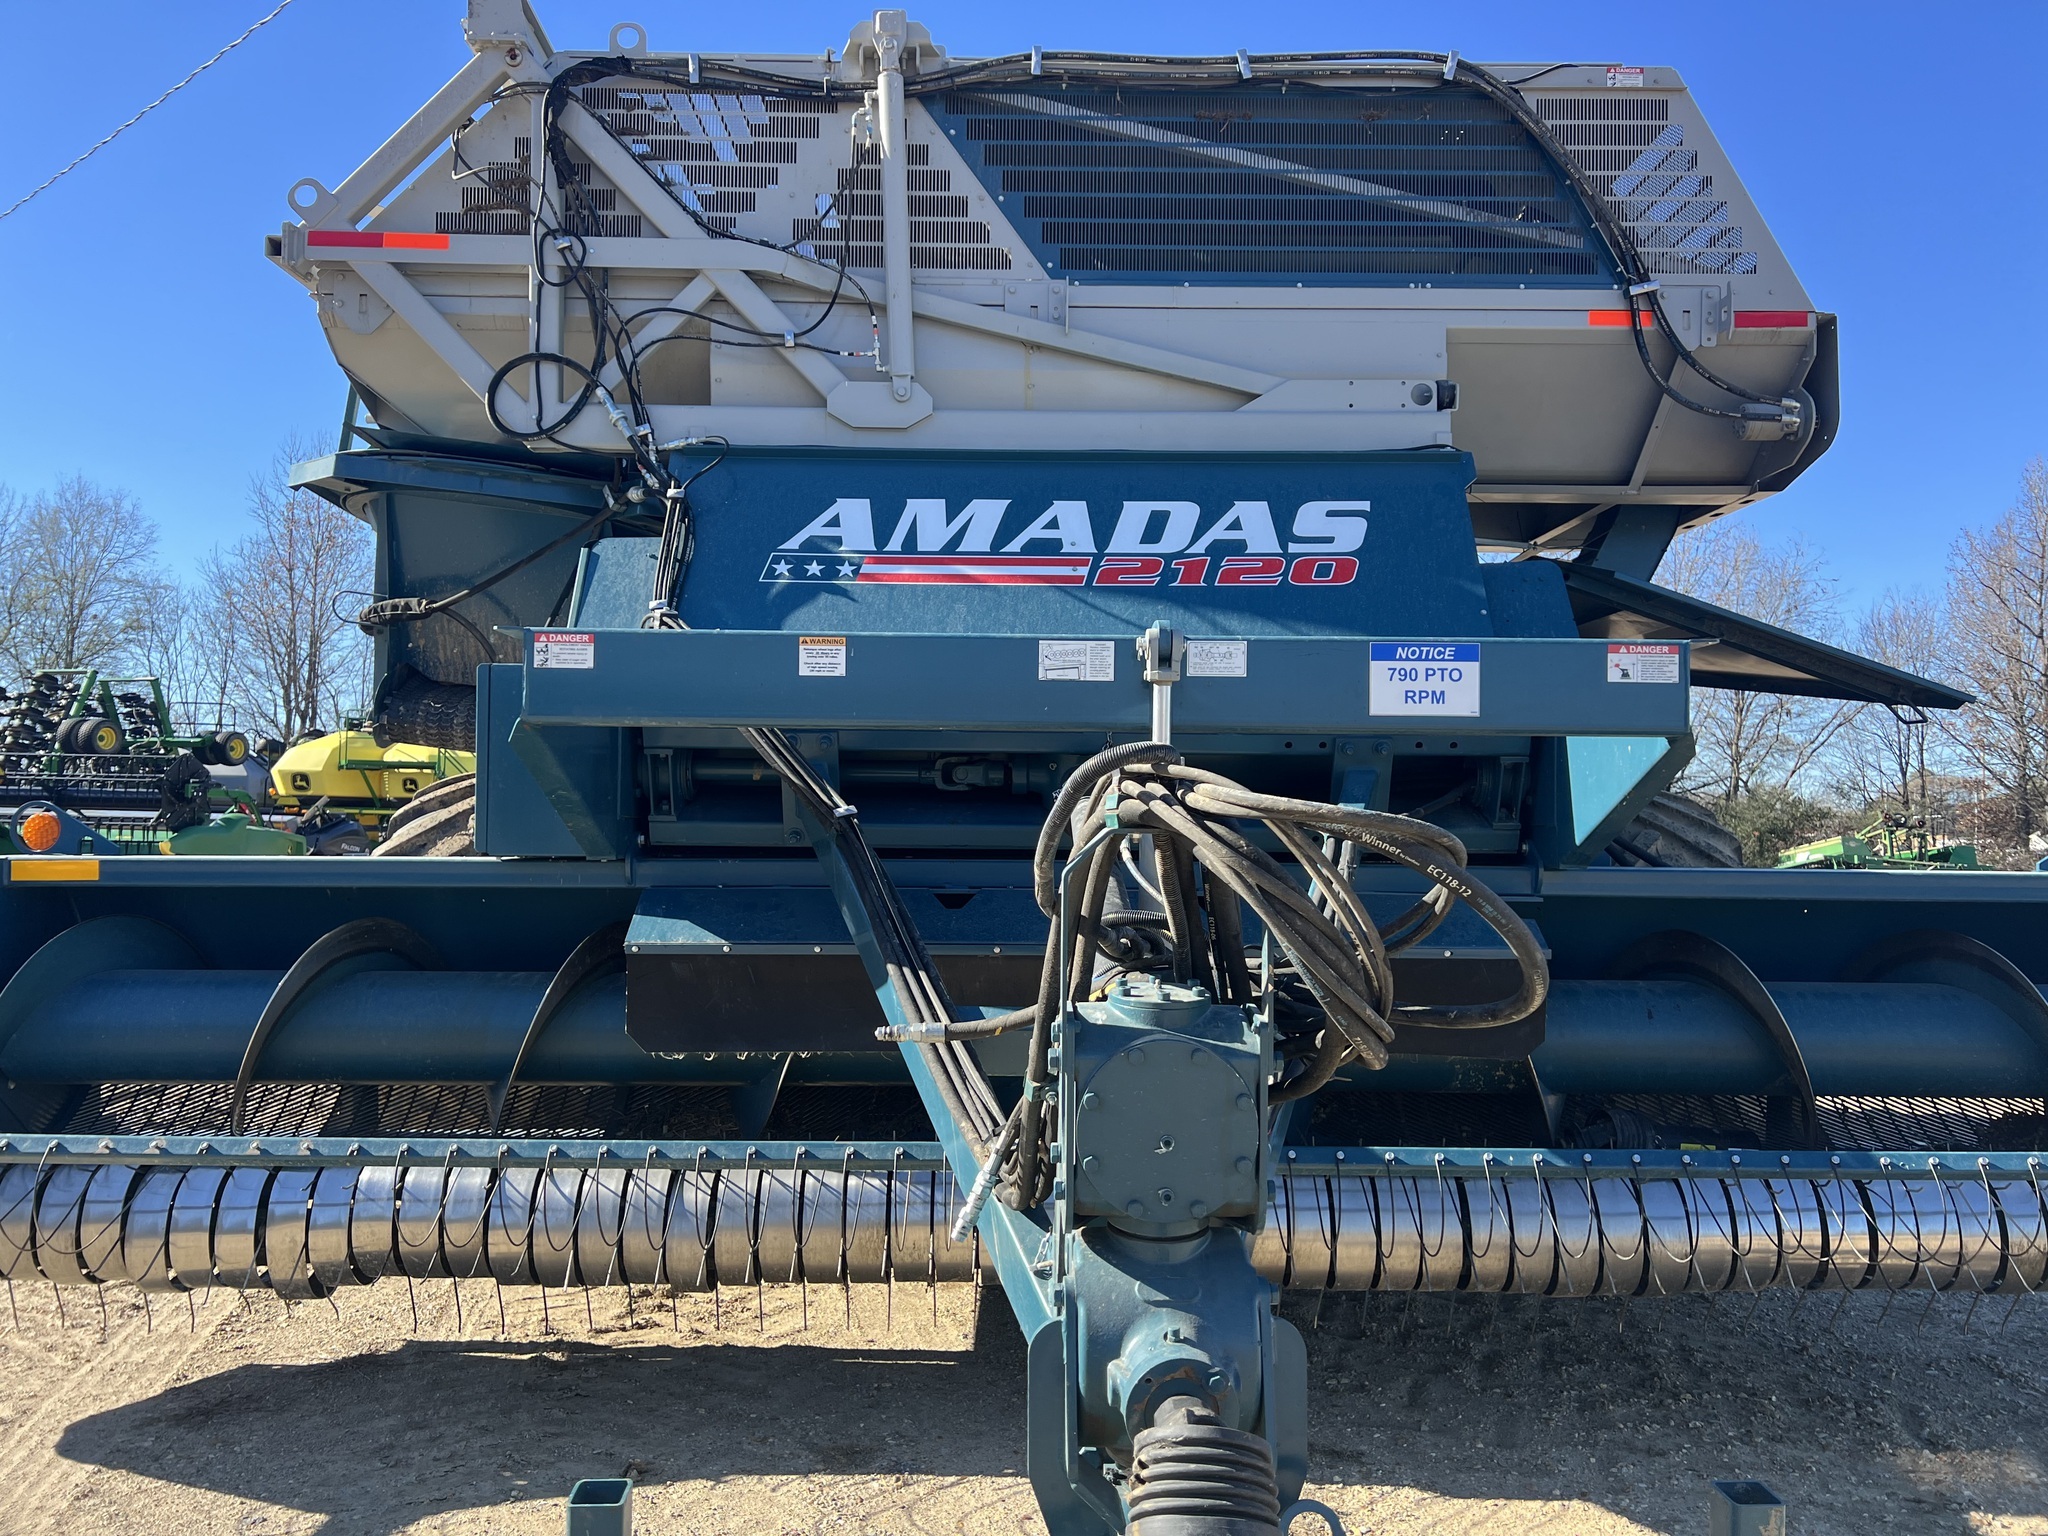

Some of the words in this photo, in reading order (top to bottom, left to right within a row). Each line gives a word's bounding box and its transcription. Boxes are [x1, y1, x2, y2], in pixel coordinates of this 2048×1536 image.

[776, 498, 1371, 554] AMADAS
[1092, 556, 1360, 587] 2120
[550, 634, 589, 642] DANGER
[1395, 646, 1456, 660] NOTICE
[1629, 645, 1669, 654] DANGER
[1387, 667, 1418, 682] 790
[1425, 667, 1463, 682] PTO
[1404, 690, 1445, 705] RPM
[341, 843, 361, 852] FALCON
[1361, 832, 1402, 856] Winner
[1426, 864, 1473, 898] EC118-12
